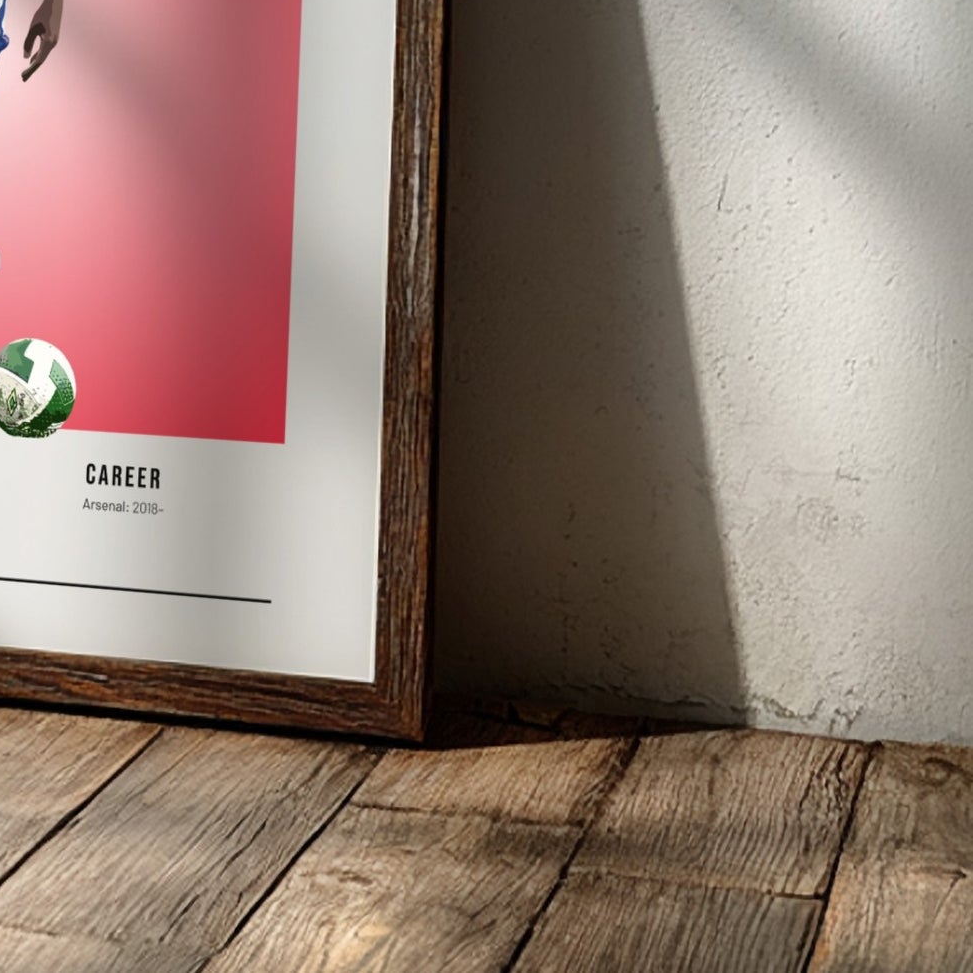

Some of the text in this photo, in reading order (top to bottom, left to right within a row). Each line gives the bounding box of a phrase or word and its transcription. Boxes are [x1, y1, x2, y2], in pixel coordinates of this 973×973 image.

[85, 463, 161, 489] CAREER
[82, 498, 164, 515] Arsenal: 2018-
